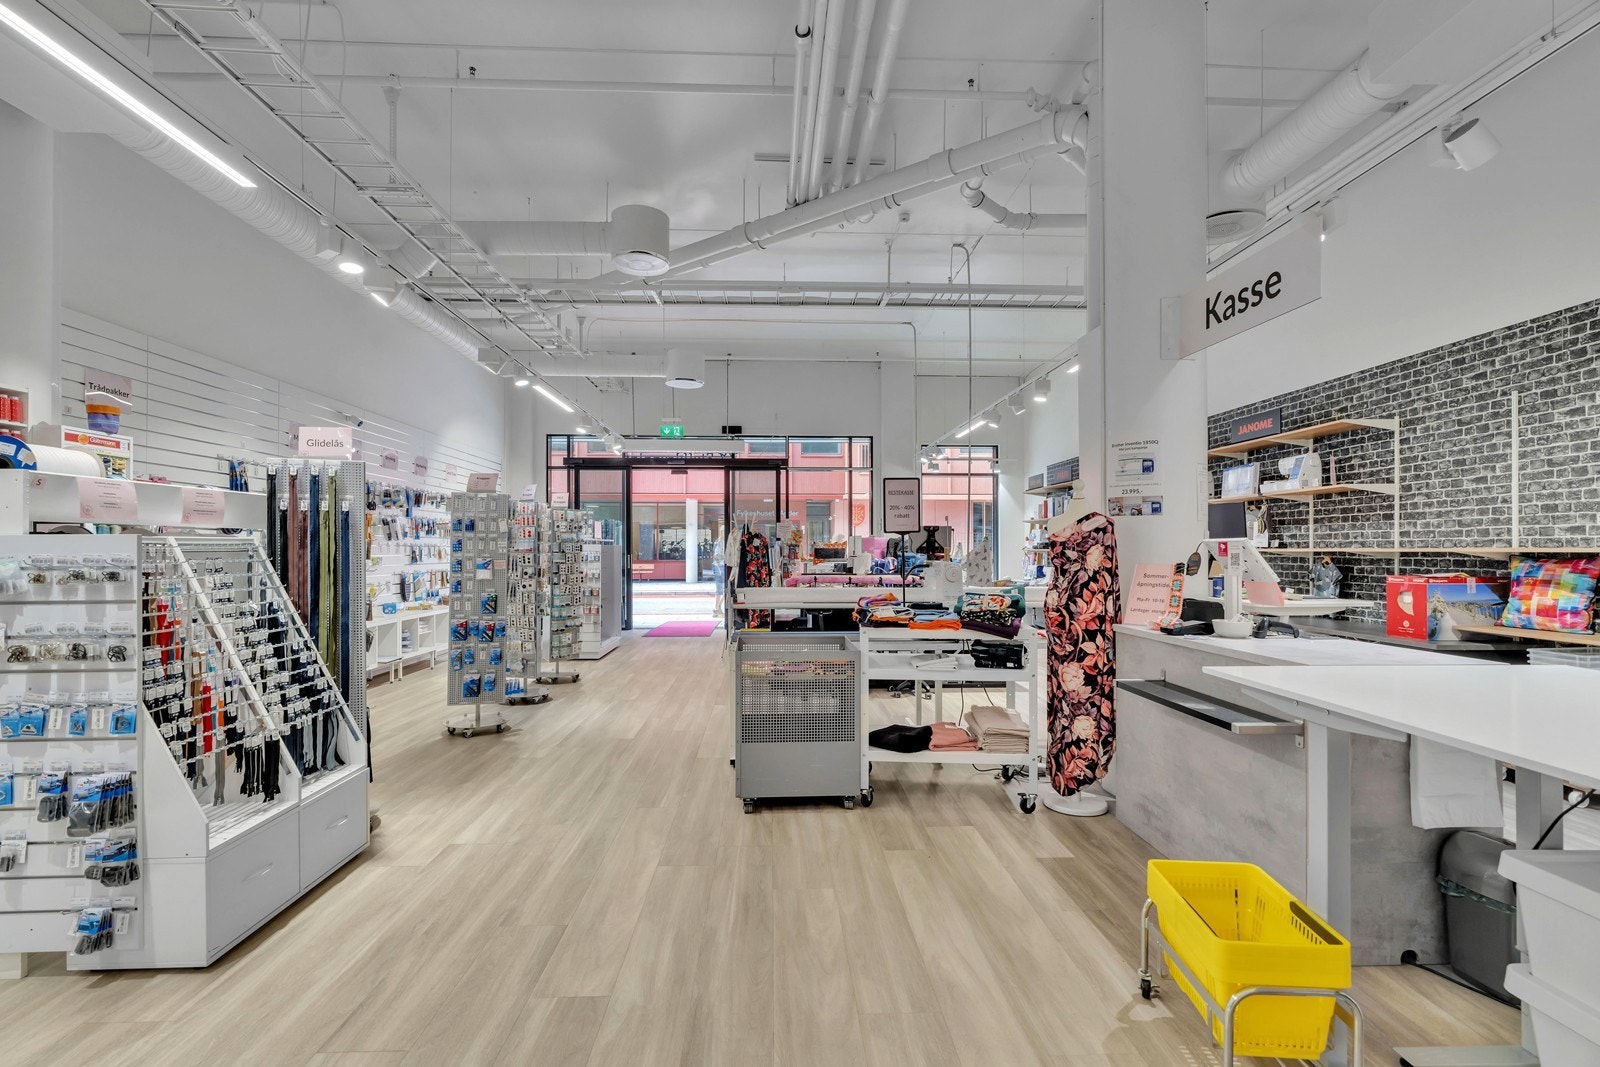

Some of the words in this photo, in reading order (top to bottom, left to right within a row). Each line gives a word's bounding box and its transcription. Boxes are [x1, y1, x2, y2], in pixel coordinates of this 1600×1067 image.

[1206, 271, 1281, 330] Kasse
[88, 381, 130, 398] Trådpakker
[1238, 418, 1273, 435] JANOME
[89, 436, 117, 448] Gütermann
[306, 438, 344, 448] Glidelås
